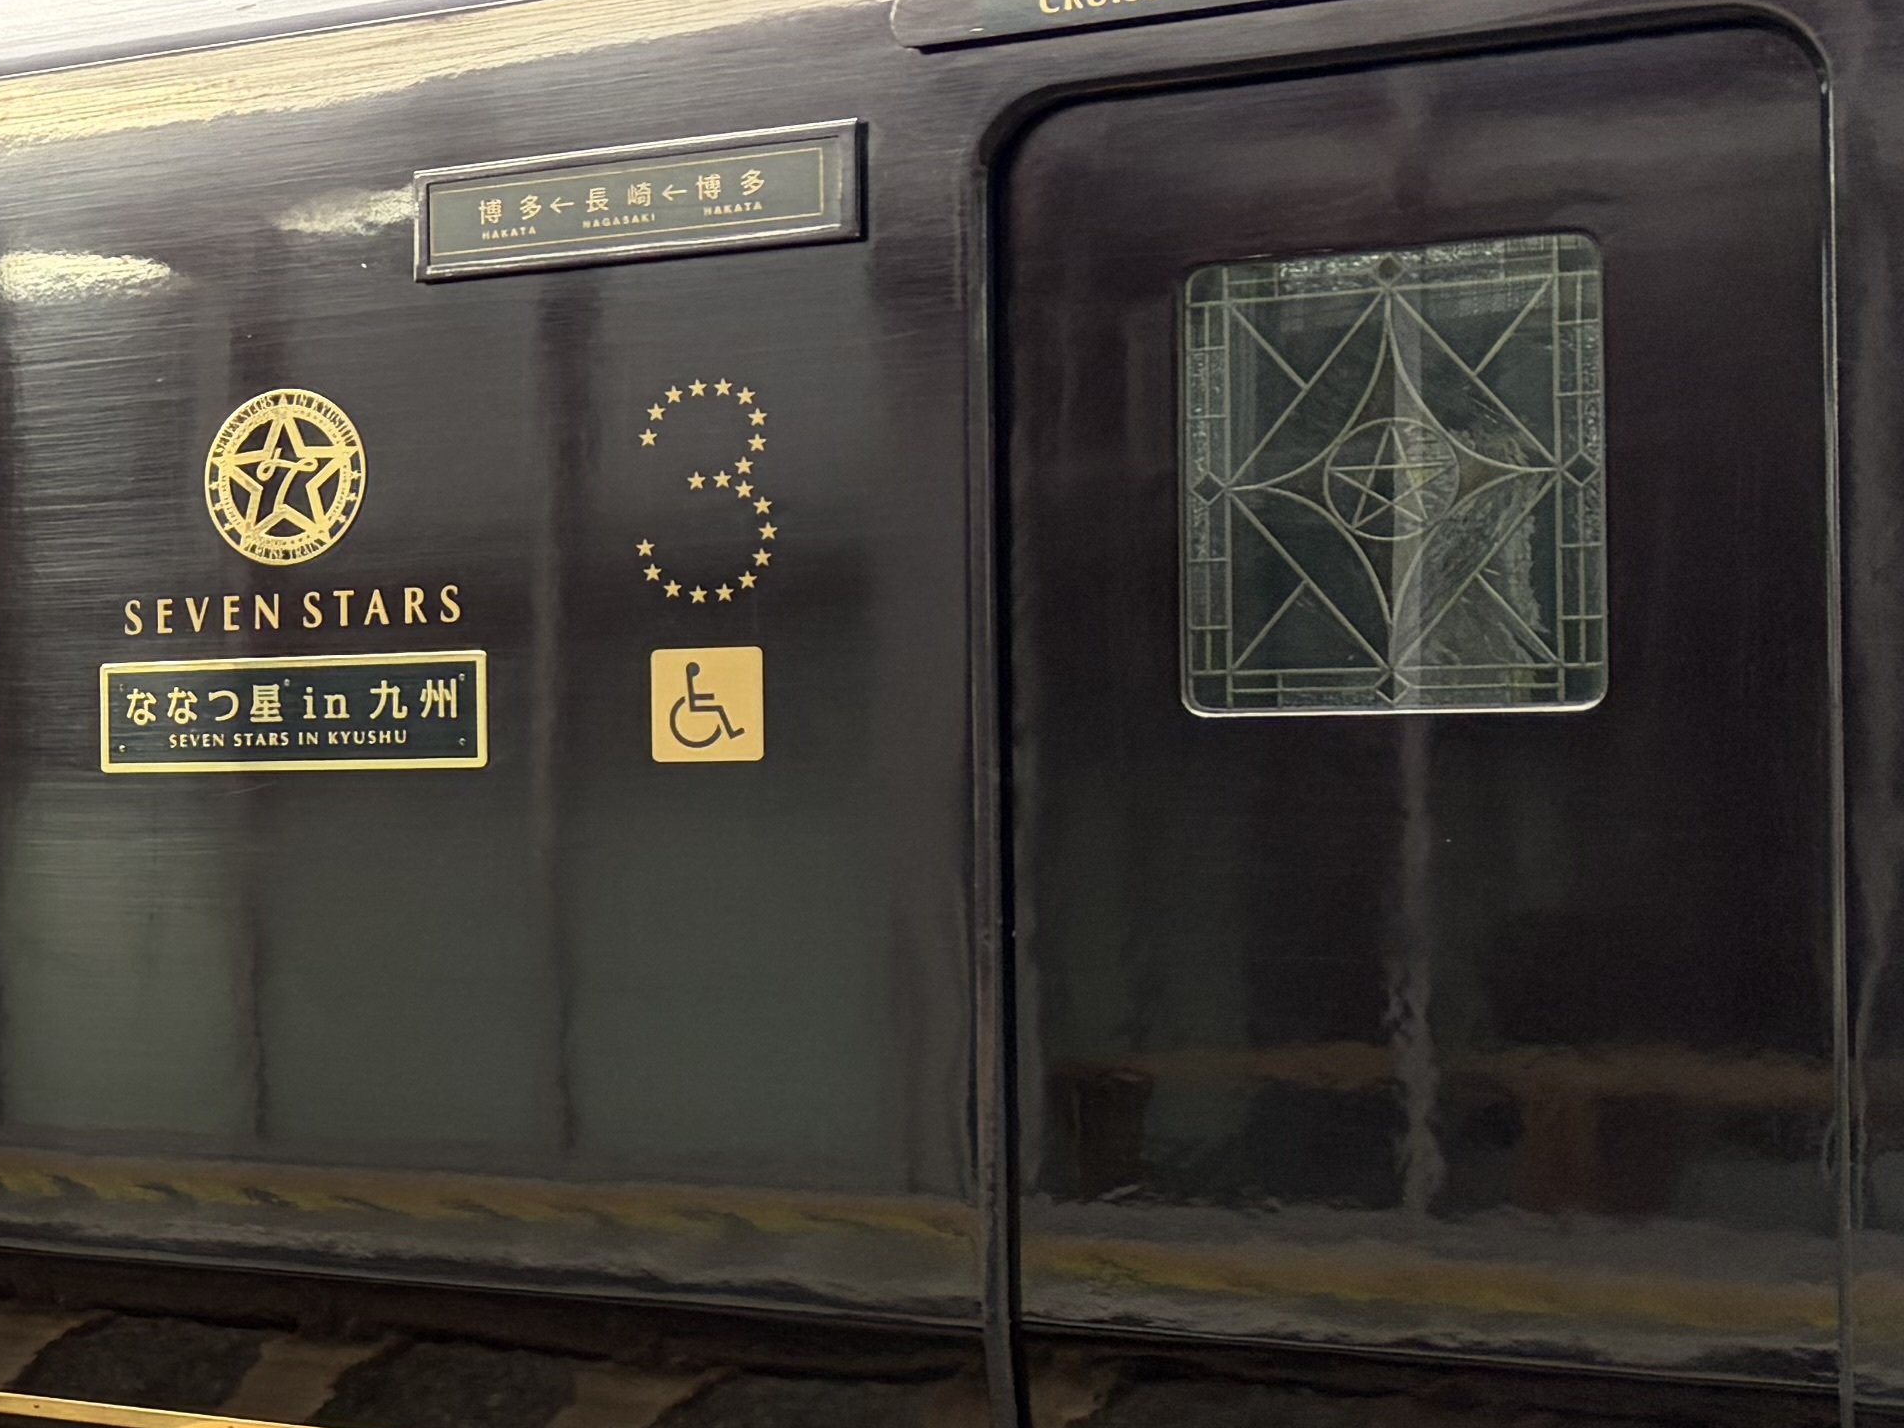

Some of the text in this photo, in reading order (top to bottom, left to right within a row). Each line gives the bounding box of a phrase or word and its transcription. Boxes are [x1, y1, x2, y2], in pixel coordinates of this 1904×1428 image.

[478, 169, 765, 225] 博多 長崎 博多
[482, 201, 763, 240] HAKATA NAGASAKI HAKATA
[124, 584, 461, 636] SEVEN STARS
[126, 677, 459, 726] ななつ星 in 九州
[169, 729, 408, 749] SEVEN STARS IN KYUSHU
